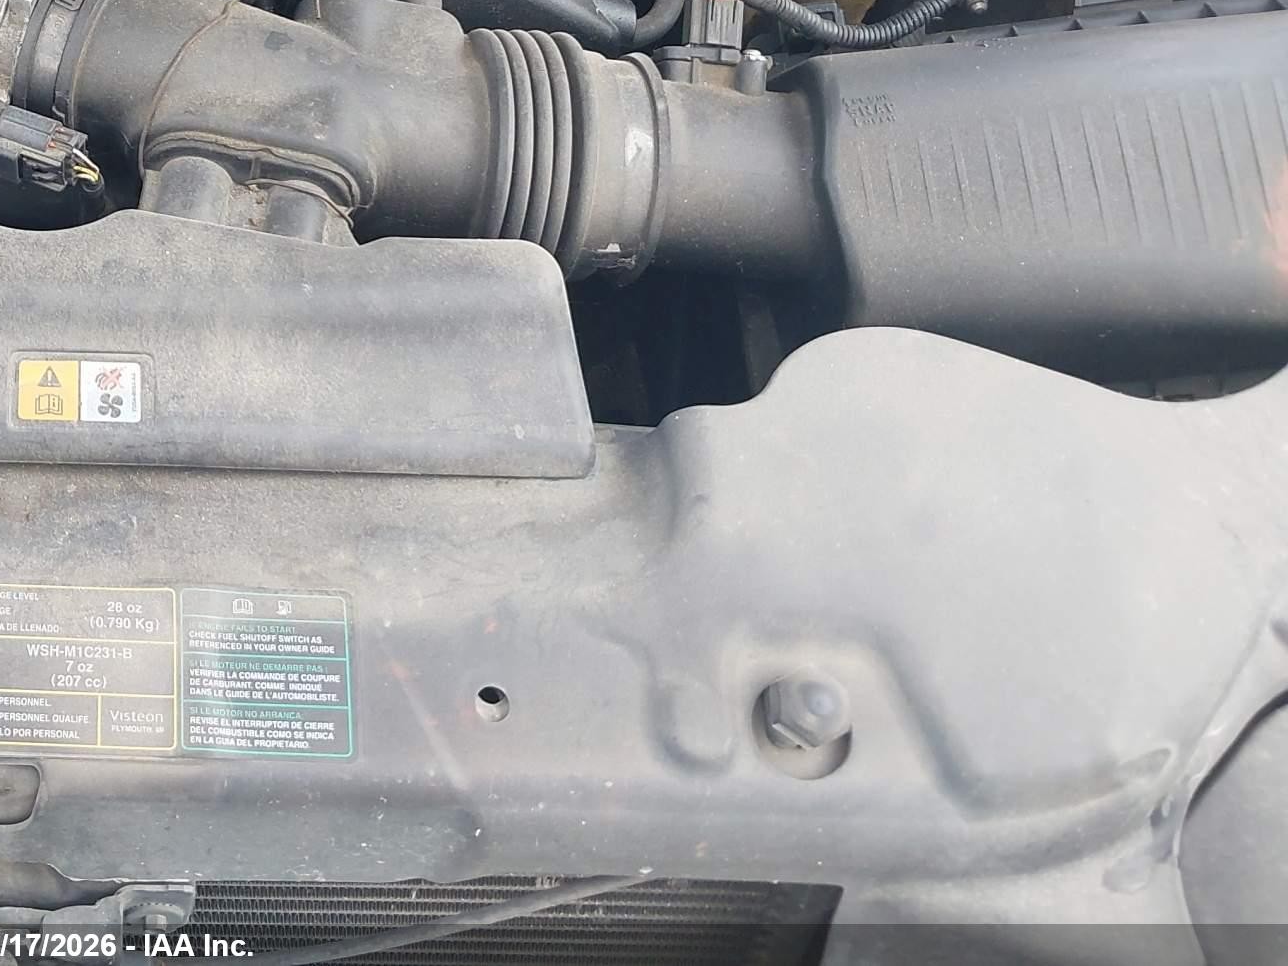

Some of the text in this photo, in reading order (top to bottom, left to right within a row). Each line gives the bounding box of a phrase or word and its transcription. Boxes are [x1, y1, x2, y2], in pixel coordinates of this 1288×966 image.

[107, 602, 142, 613] 28 oz
[7, 623, 18, 631] DE
[135, 618, 160, 632] Kg)
[270, 626, 295, 634] START
[189, 630, 216, 639] CHECK
[218, 632, 238, 640] FUEL
[240, 633, 277, 642] SHUTOFF
[279, 635, 309, 643] SWITCH
[27, 644, 133, 659] WSH-M1C231-B
[189, 640, 242, 649] REFERENCED
[254, 643, 276, 651] YOUR
[278, 644, 308, 652] OWNER
[310, 645, 335, 653] GUIDE
[66, 661, 94, 673] 7 oz
[249, 662, 260, 670] NE
[51, 674, 107, 689] (207 cc)
[227, 670, 237, 679] LA
[239, 671, 285, 680] COMMANDE
[288, 673, 298, 681] DE
[301, 673, 340, 682] COUPURE
[255, 682, 285, 690] COMME
[190, 688, 212, 696] DANS
[225, 690, 249, 698] GUIDE
[252, 691, 263, 699] DE
[0, 712, 50, 722] PERSONNEL
[110, 710, 164, 723] Visteon
[190, 716, 218, 725] REVISE
[221, 718, 230, 726] EL
[233, 719, 289, 729] INTERRUPTOR
[304, 722, 335, 730] CIERRE
[13, 728, 31, 737] POR
[33, 729, 79, 739] PERSONAL
[190, 726, 334, 740] DEL COMBUSTIBLE COMO SE INDICA
[190, 736, 201, 744] EN
